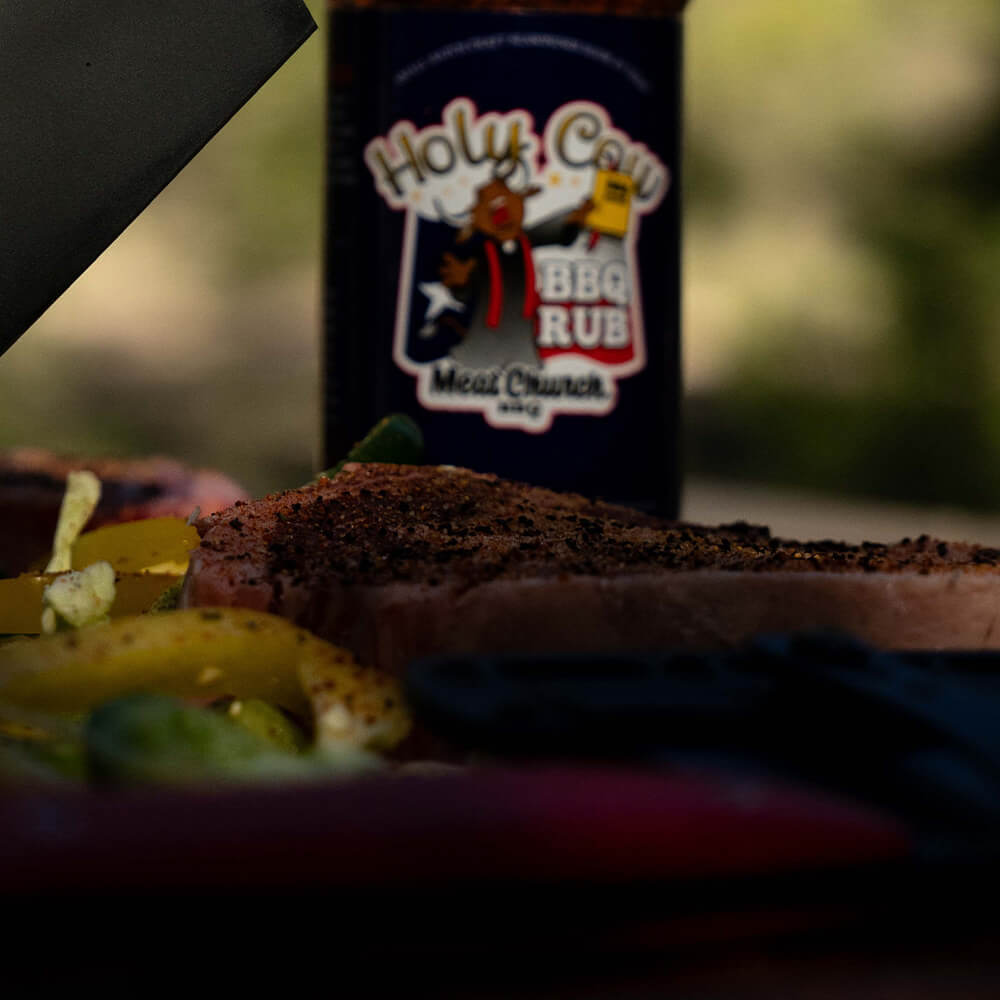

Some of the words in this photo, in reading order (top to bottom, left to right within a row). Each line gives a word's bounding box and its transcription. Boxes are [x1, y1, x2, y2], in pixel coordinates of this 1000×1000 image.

[373, 107, 531, 197] Holy
[540, 259, 628, 305] BBQ
[537, 305, 629, 347] RUB
